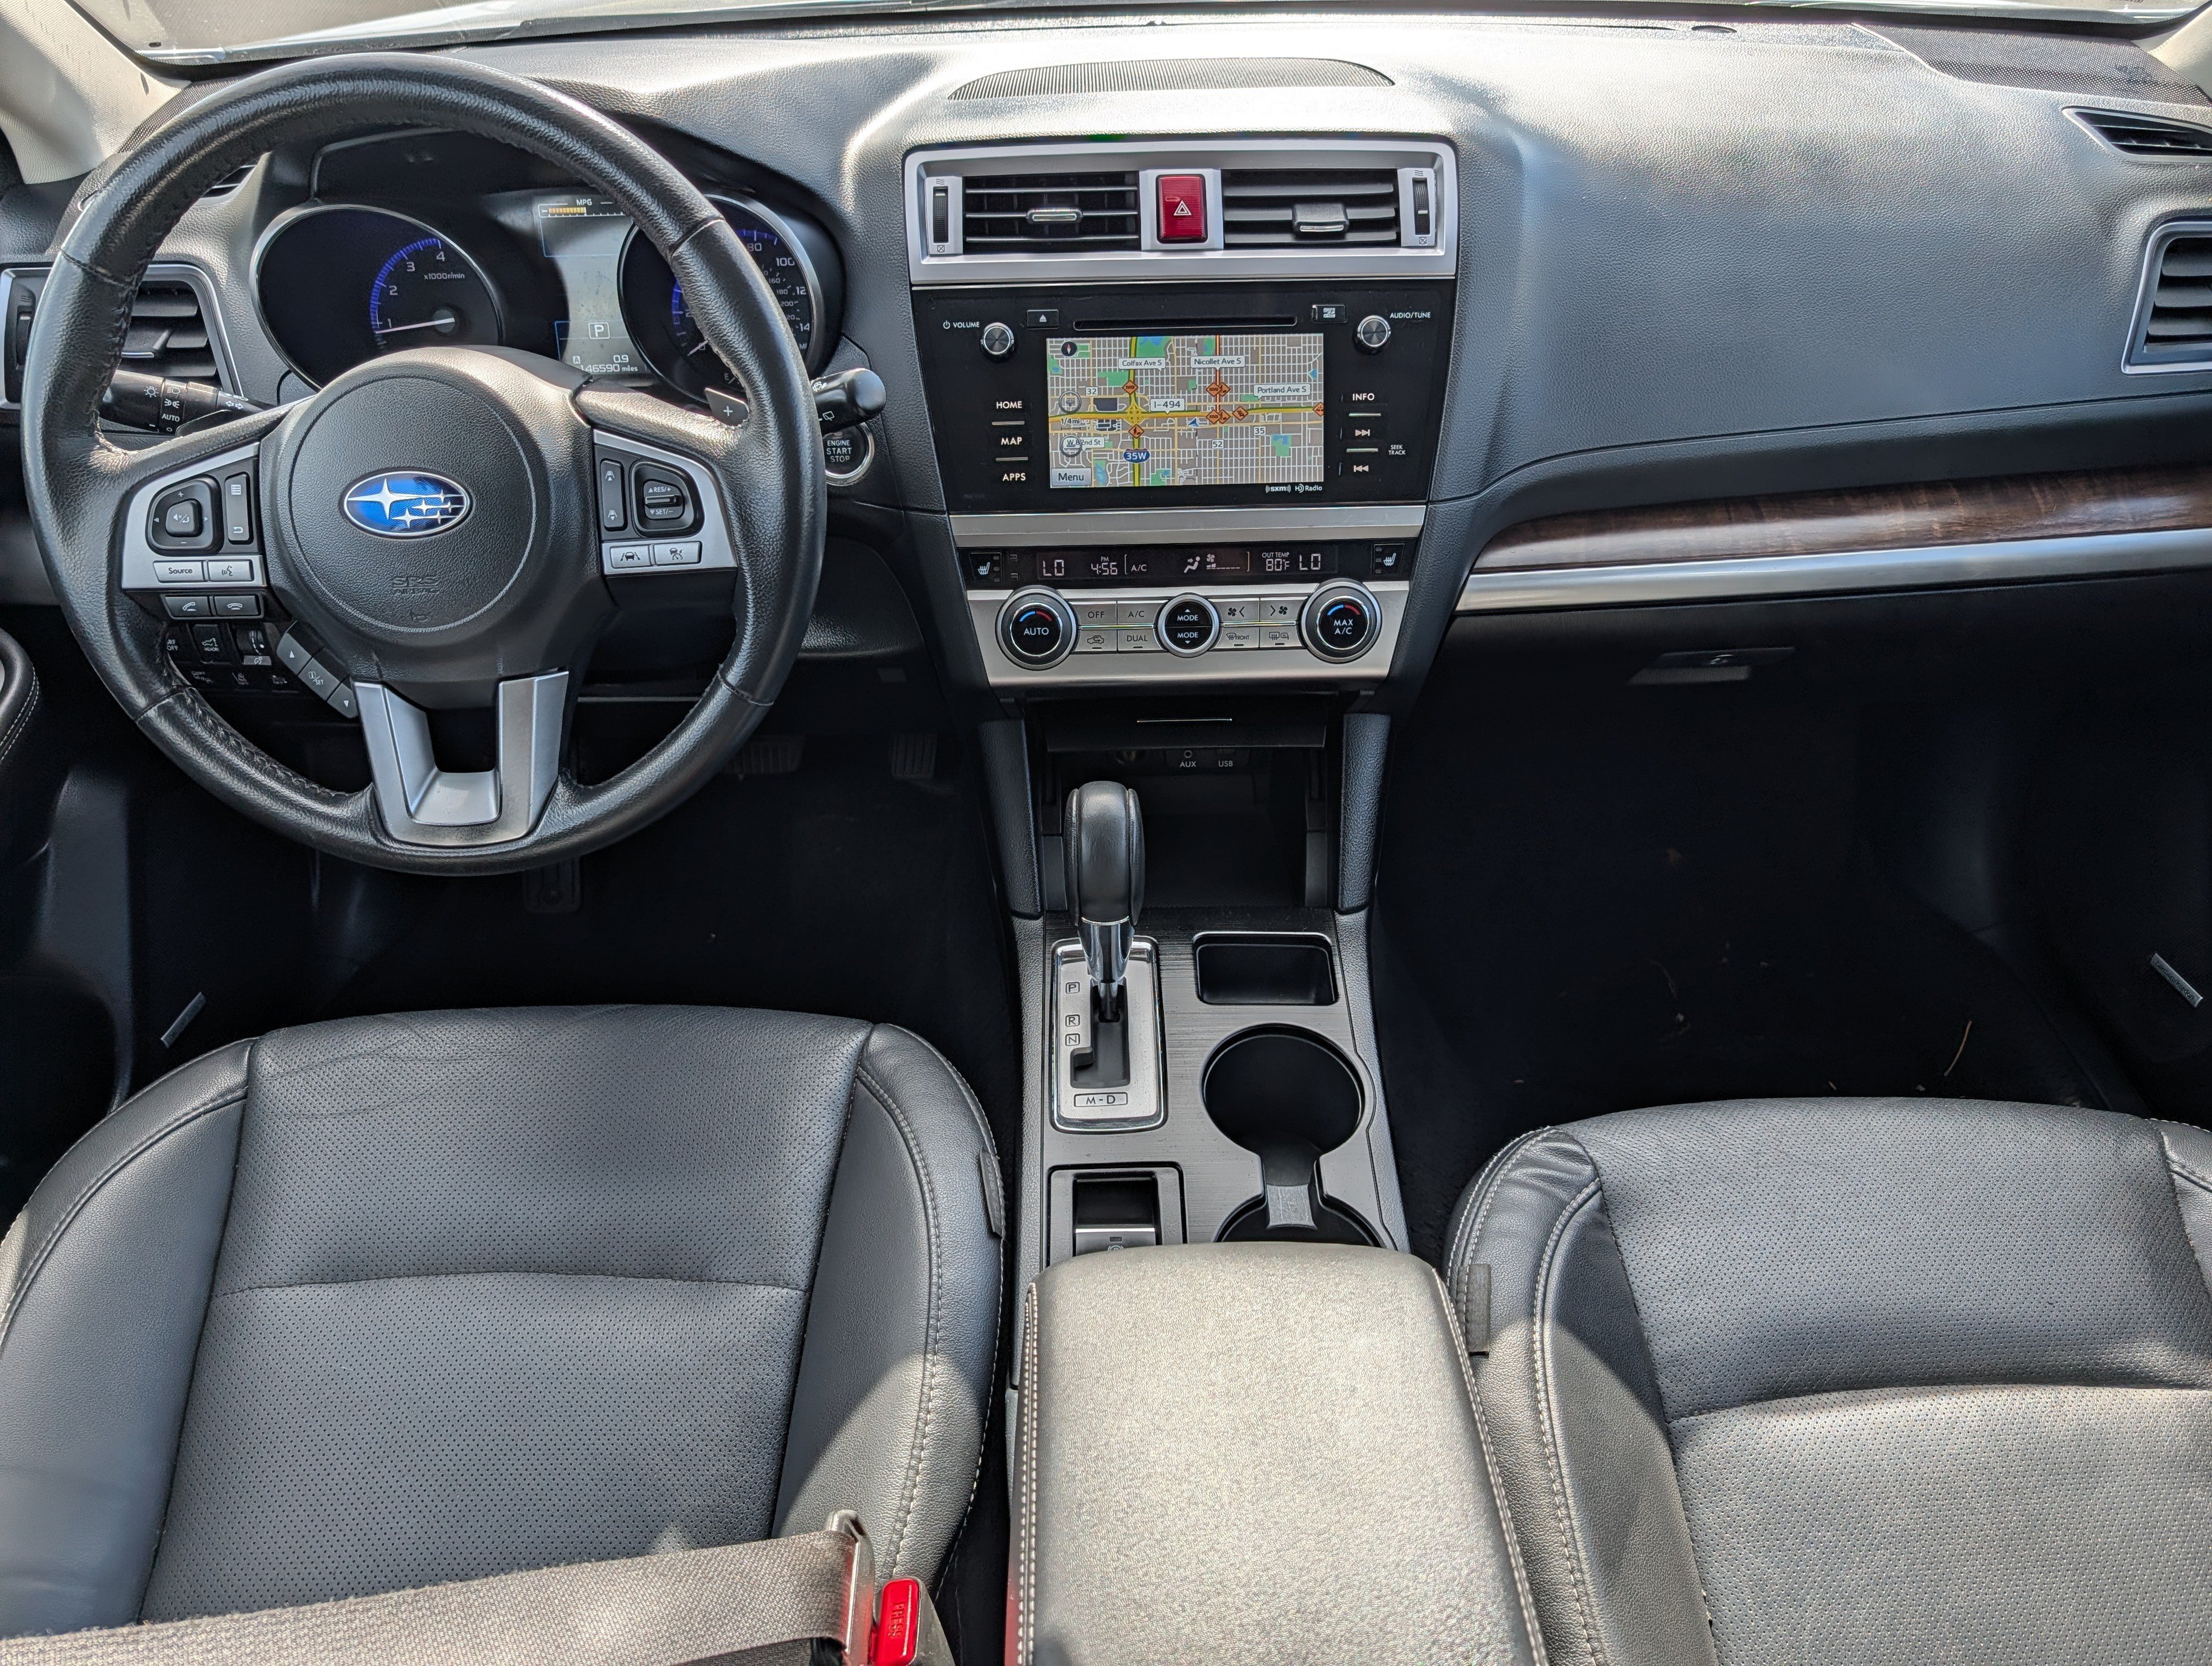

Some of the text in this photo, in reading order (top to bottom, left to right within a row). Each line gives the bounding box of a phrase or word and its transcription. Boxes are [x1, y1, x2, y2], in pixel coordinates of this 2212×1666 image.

[747, 243, 762, 252] 80
[436, 252, 445, 261] 4
[776, 258, 795, 266] 100
[407, 262, 415, 272] 3
[389, 286, 398, 295] 2
[796, 286, 806, 295] 12
[388, 318, 391, 328] 1
[800, 323, 810, 331] 14
[594, 325, 604, 337] P
[573, 354, 629, 364] A 0.9
[580, 364, 620, 373] 146590
[996, 401, 1023, 409] HOME
[162, 413, 180, 422] AUTO
[1001, 437, 1023, 445] MAP
[1002, 473, 1026, 482] APPS
[1058, 472, 1084, 482] Menu
[1091, 562, 1118, 575] 4:56
[1131, 564, 1147, 572] A/C
[1088, 611, 1105, 619] OFF
[1128, 610, 1144, 618] A/C
[1023, 627, 1049, 636] AUTO
[1334, 627, 1353, 636] A/C
[1068, 984, 1076, 992] P
[1069, 1017, 1077, 1026] R
[1069, 1035, 1077, 1045] N
[888, 1601, 905, 1639] PRESS
